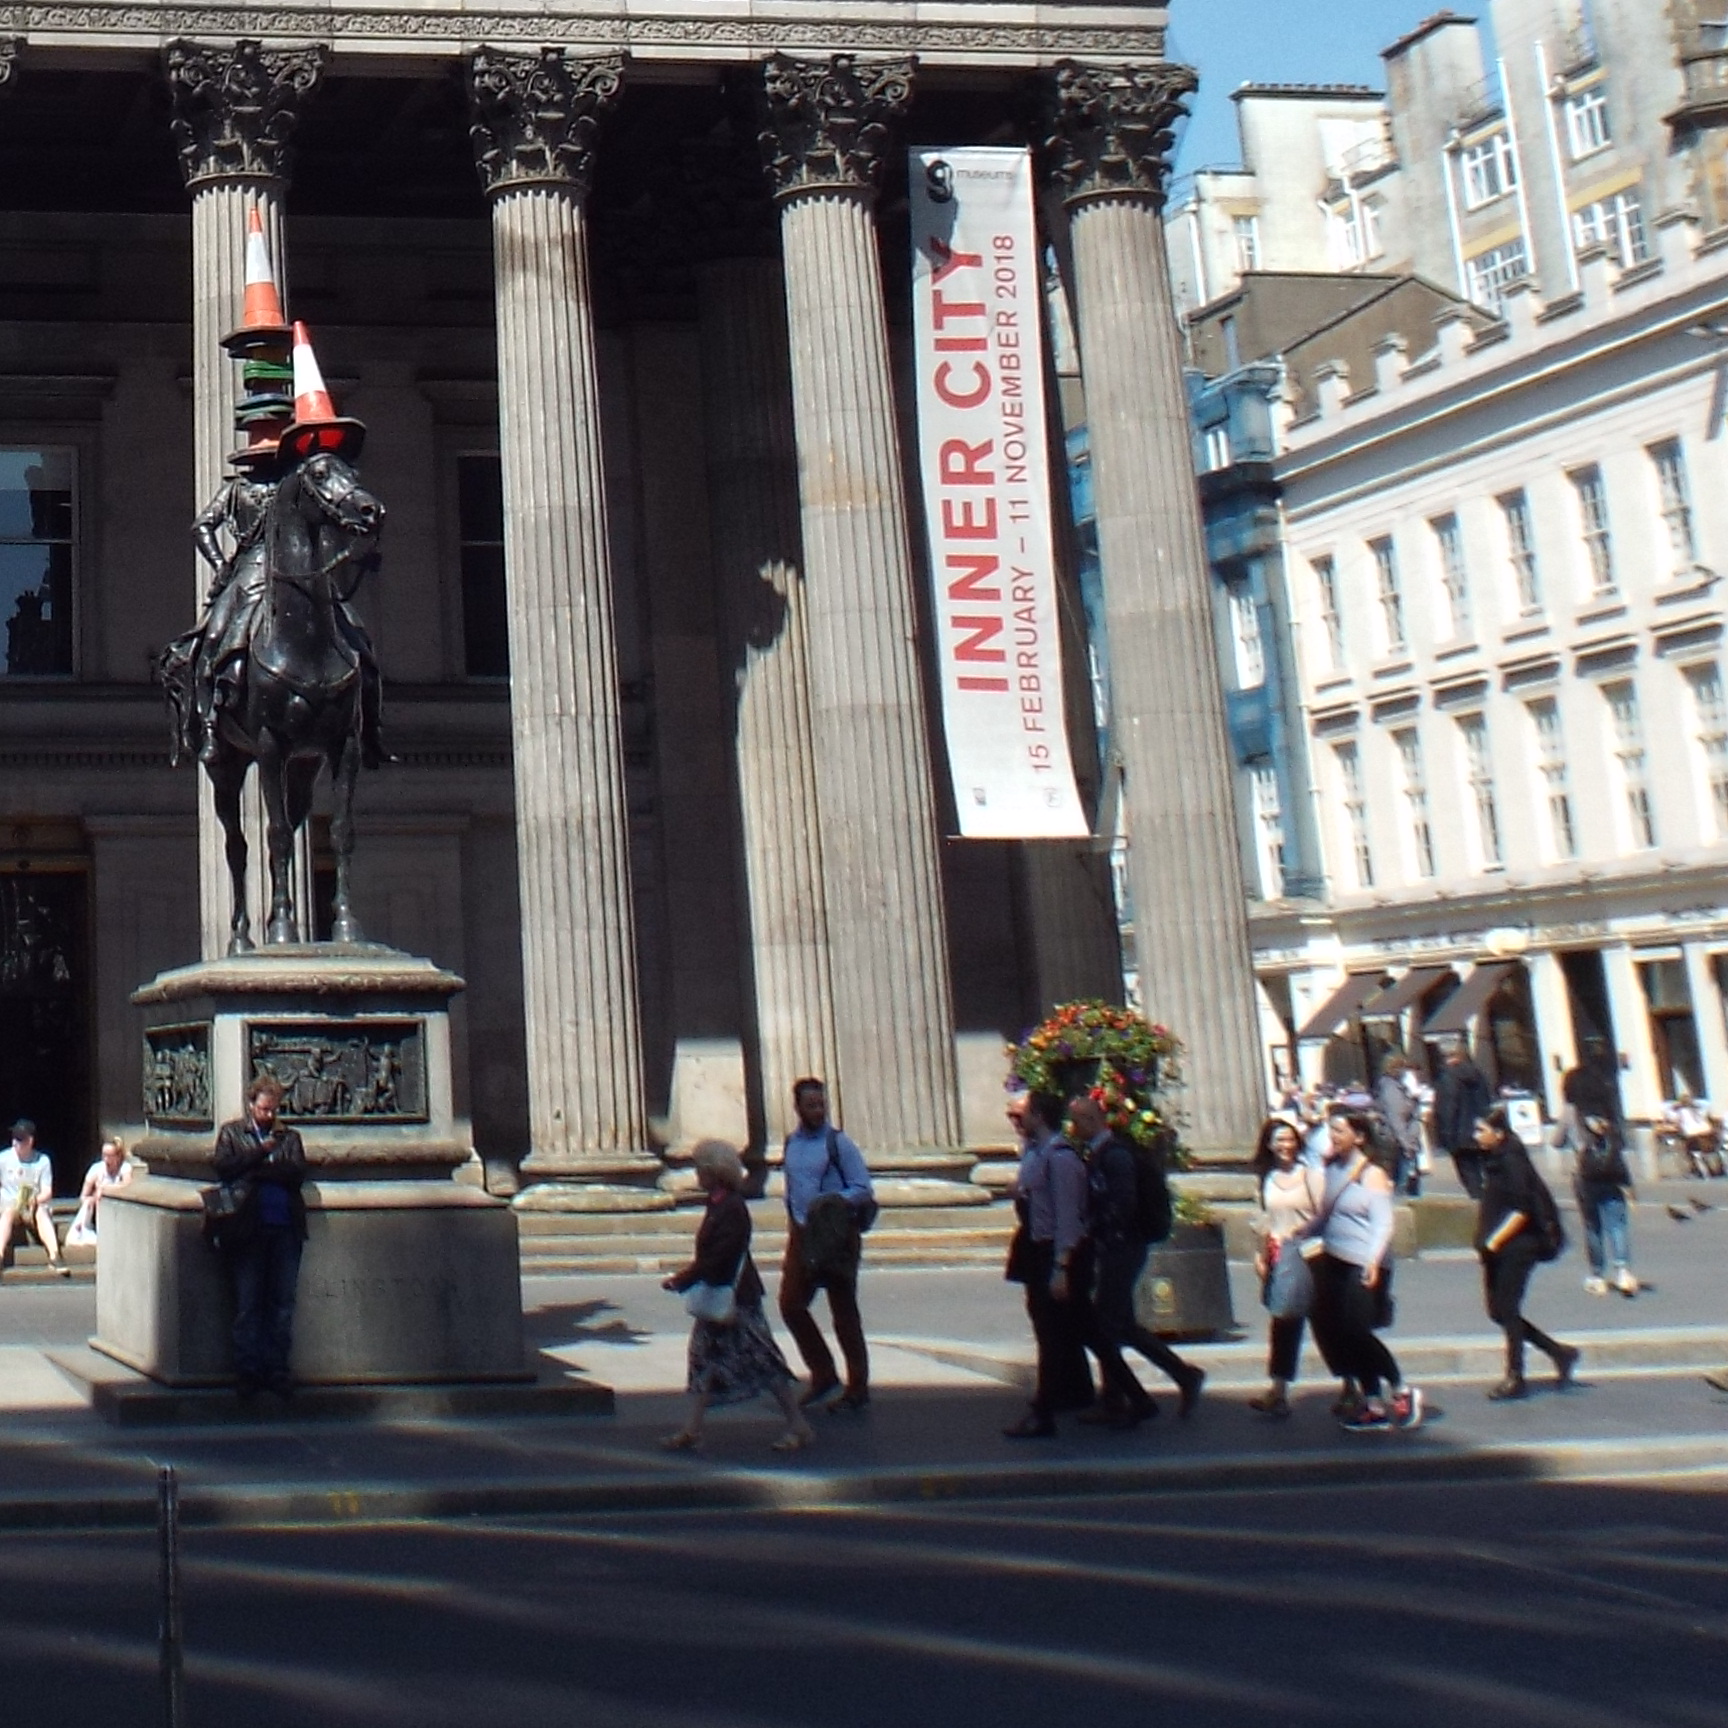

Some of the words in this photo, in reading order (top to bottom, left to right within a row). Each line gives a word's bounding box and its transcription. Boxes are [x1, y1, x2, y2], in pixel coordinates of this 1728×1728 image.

[956, 168, 1014, 180] museums
[931, 235, 993, 410] CITY
[993, 234, 1017, 299] 2018
[995, 310, 1029, 484] NOVEMBER
[939, 437, 1010, 692] INNER
[1008, 499, 1031, 524] 11
[1011, 565, 1045, 733] FEBRUARY
[1029, 744, 1053, 769] 15
